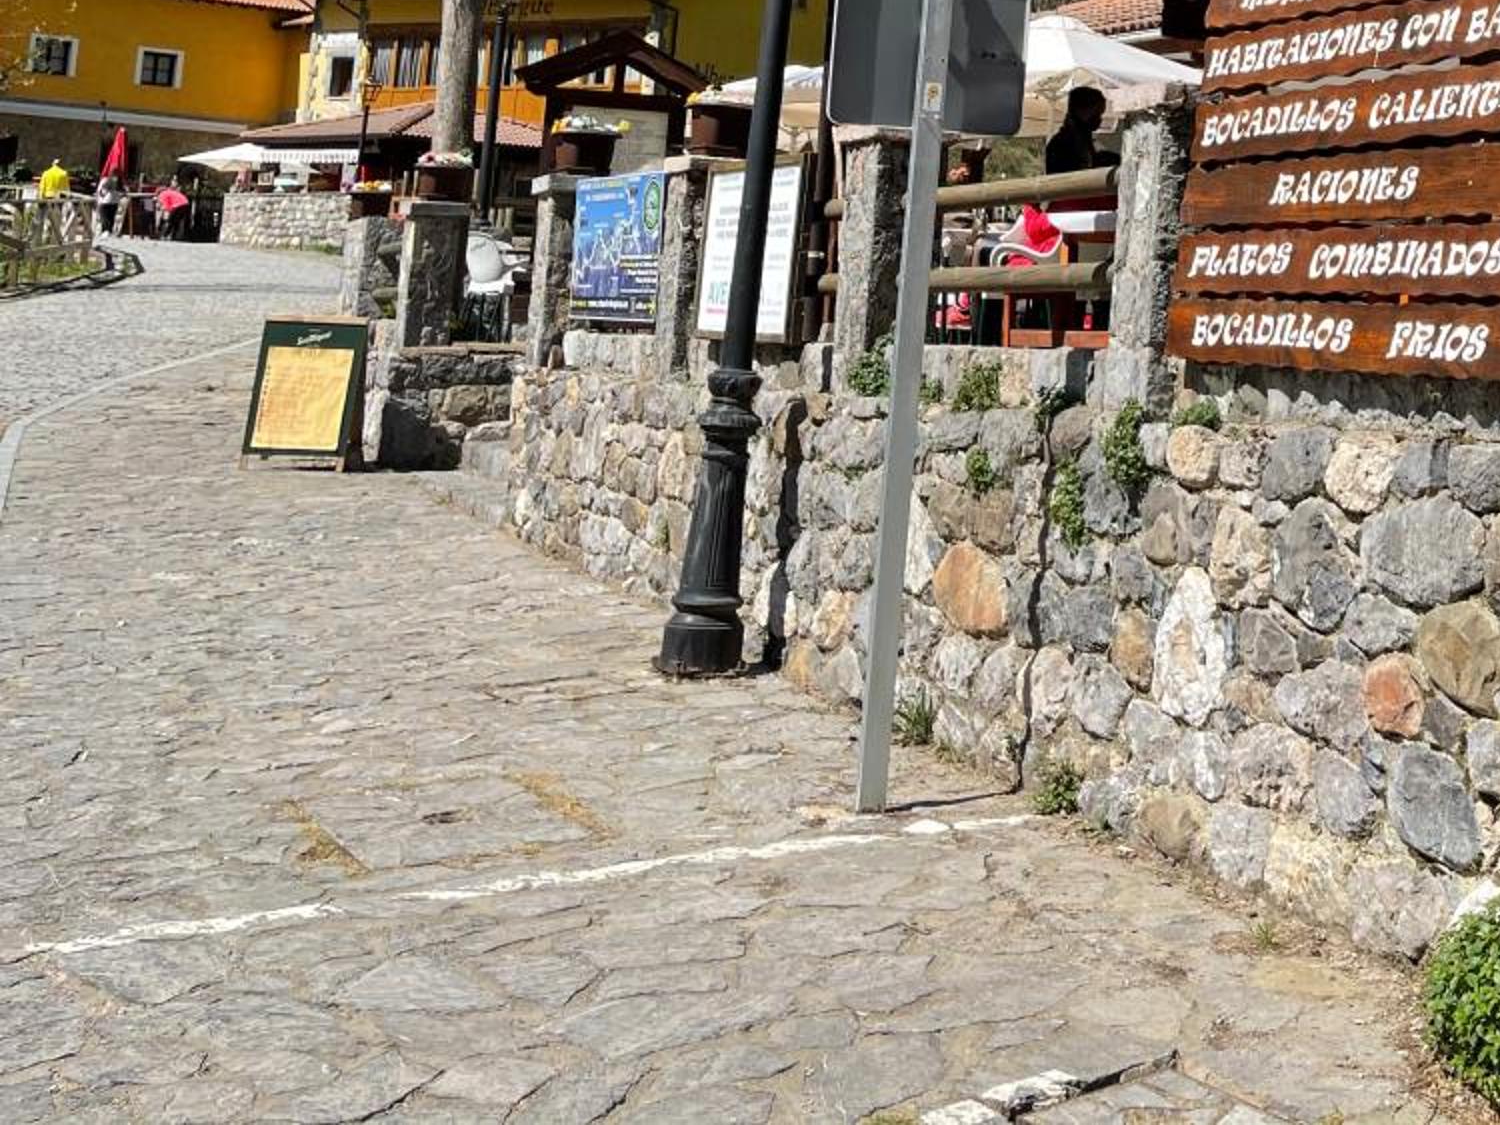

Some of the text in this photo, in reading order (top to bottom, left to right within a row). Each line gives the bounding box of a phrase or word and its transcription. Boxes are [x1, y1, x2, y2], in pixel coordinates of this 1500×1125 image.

[1205, 18, 1397, 78] HABITACIONES
[1402, 7, 1458, 50] CON
[1200, 98, 1357, 147] BOCADILLOS
[1268, 165, 1420, 207] RACIONES
[1187, 241, 1293, 278] PLATOS
[1191, 312, 1490, 363] BOCADILLOS FRIOS
